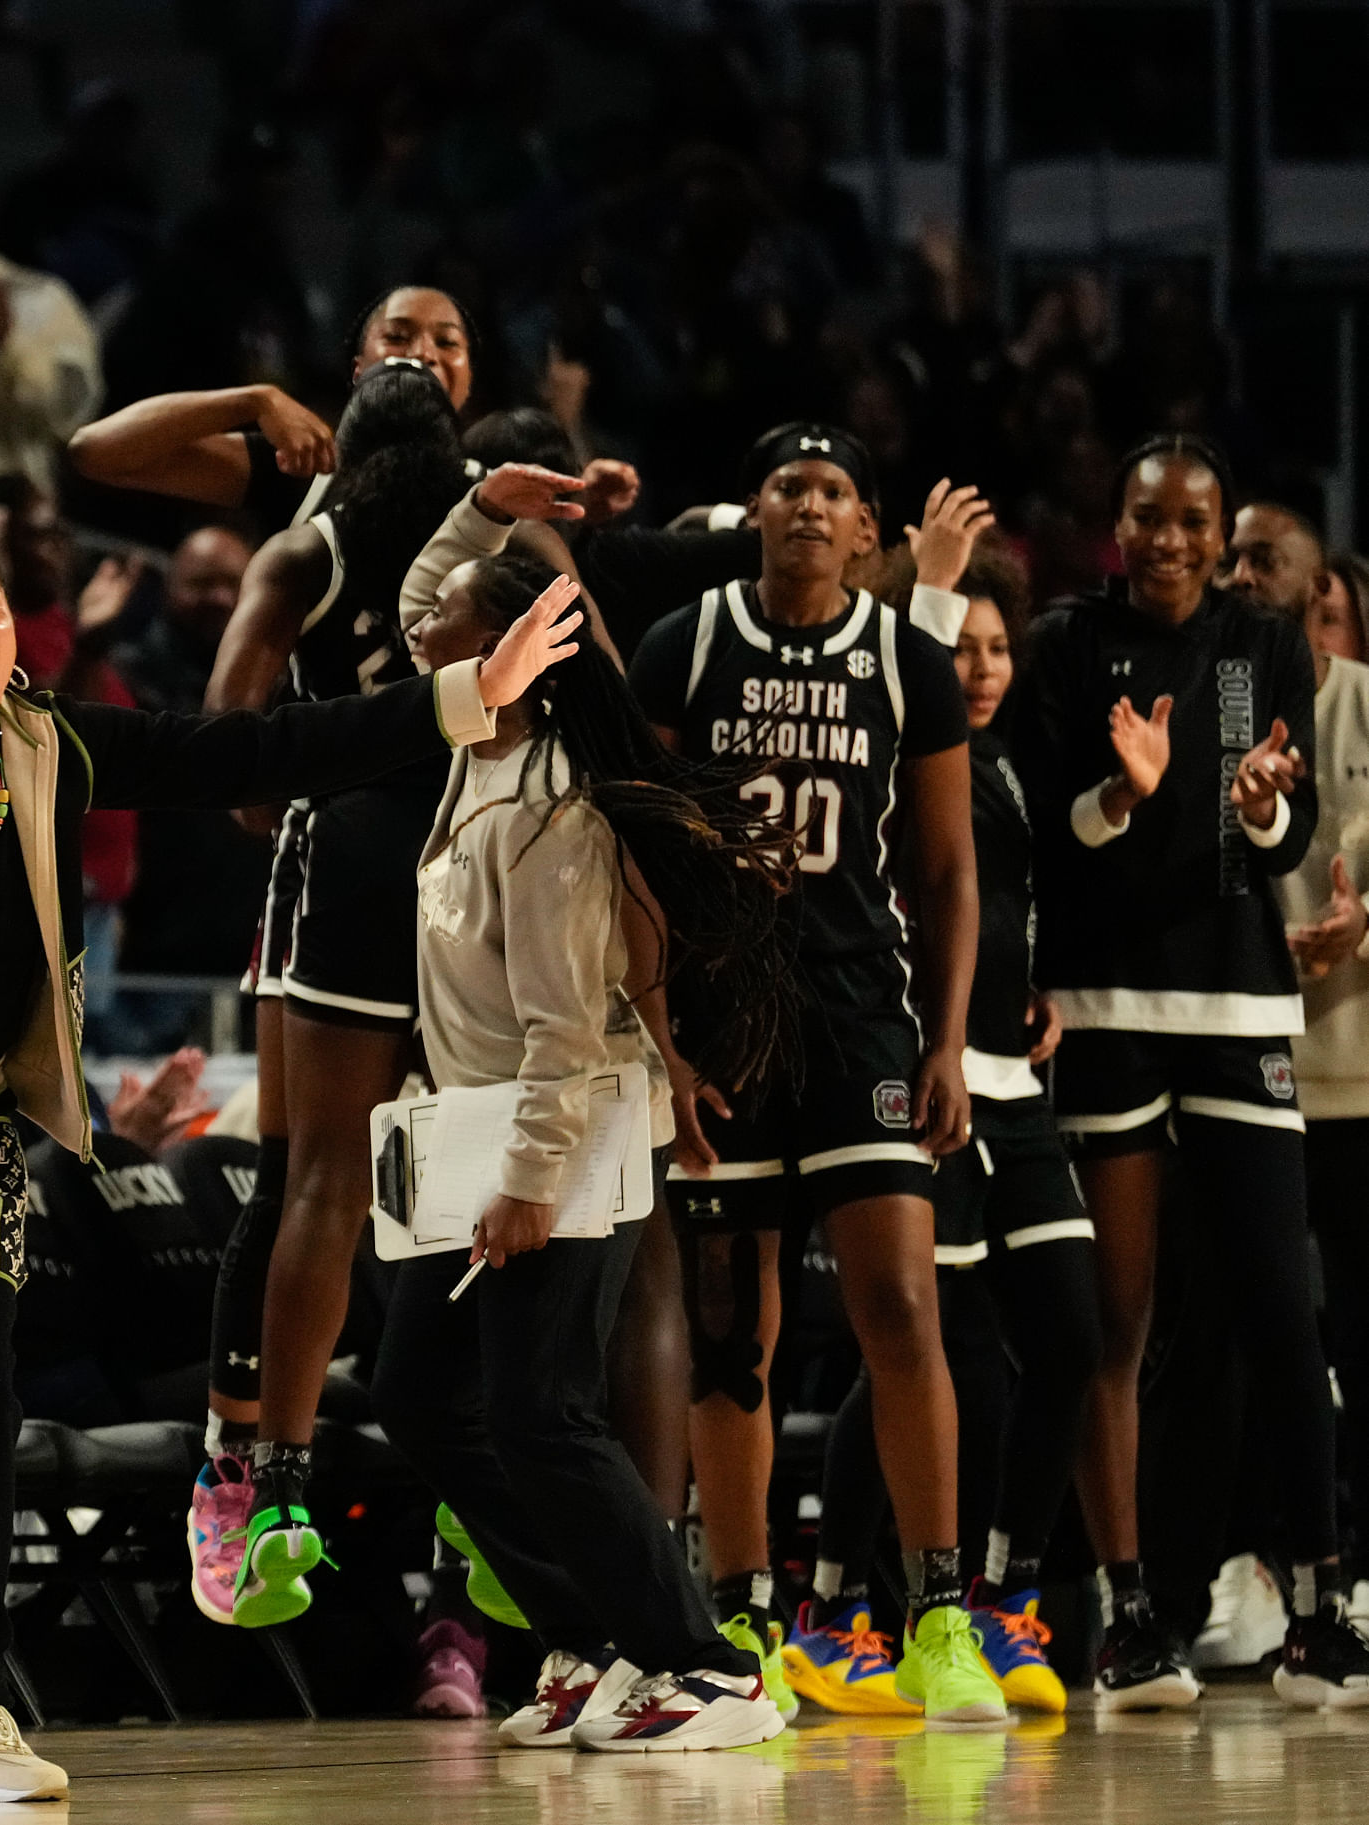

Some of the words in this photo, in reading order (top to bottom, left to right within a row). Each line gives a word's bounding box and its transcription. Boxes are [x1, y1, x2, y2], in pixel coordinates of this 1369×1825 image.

[846, 648, 877, 680] SEC
[742, 676, 848, 720] SOUTH
[1216, 657, 1254, 750] SOUTH
[710, 717, 871, 768] CAROLINA
[735, 772, 844, 874] 20
[90, 1162, 185, 1213] LUCKY
